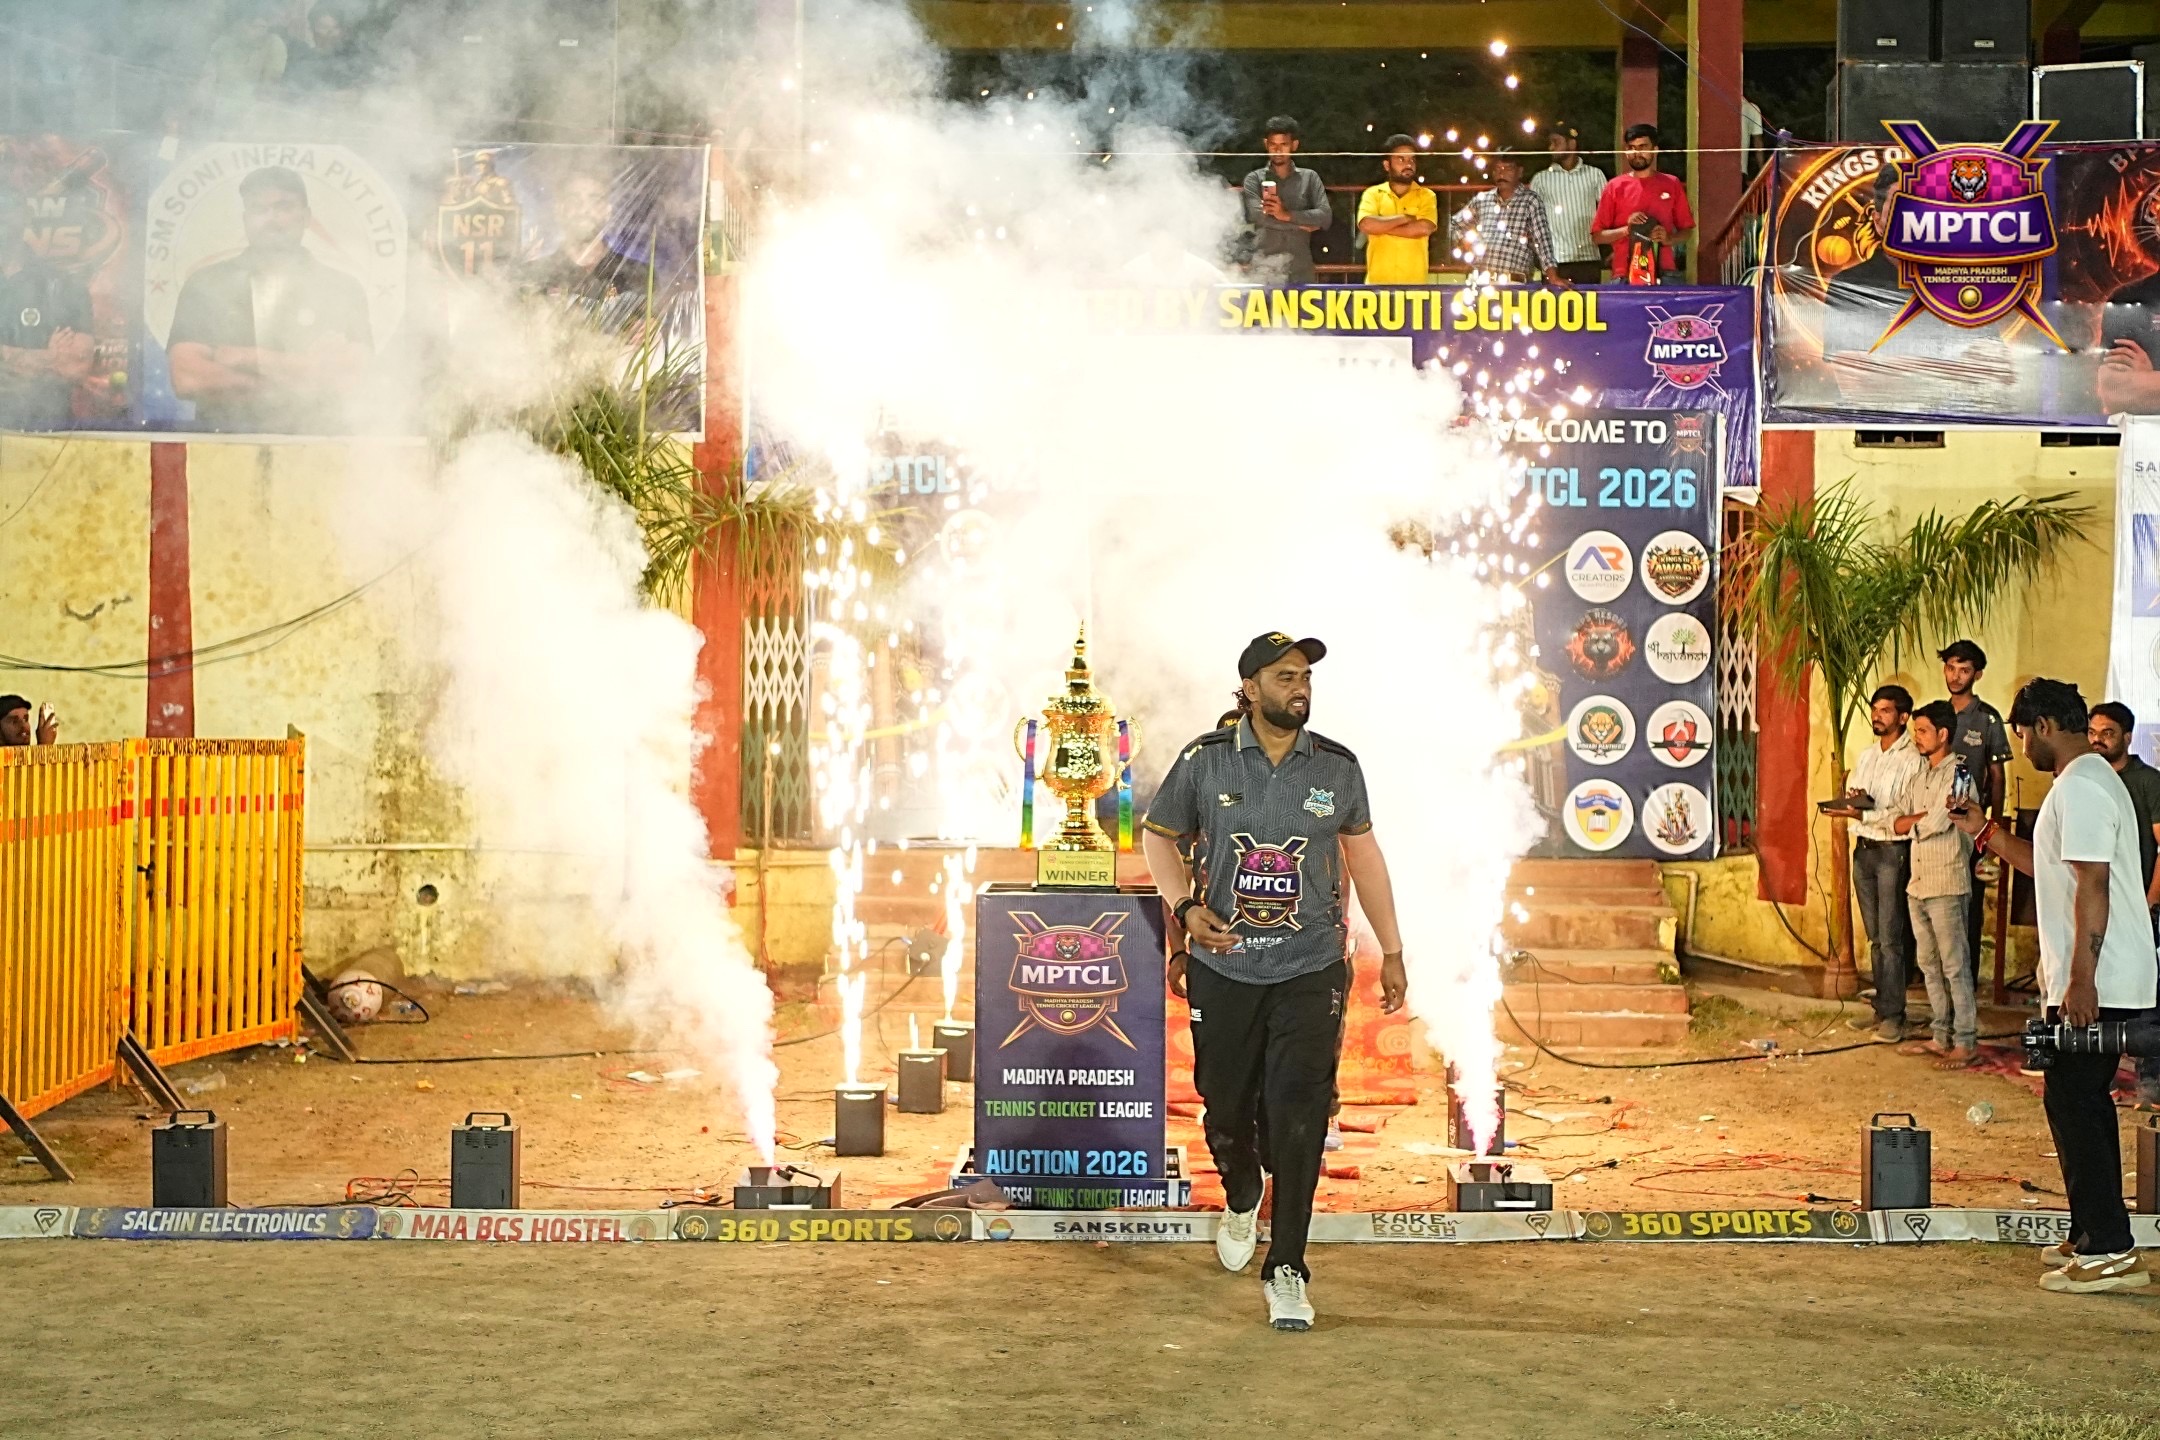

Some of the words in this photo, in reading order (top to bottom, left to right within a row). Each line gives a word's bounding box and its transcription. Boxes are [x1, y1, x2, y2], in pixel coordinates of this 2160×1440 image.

[1800, 149, 1881, 210] KINGS
[148, 216, 177, 262] SM
[163, 157, 224, 216] SONI
[231, 144, 317, 172] INFRA
[323, 158, 377, 203] PVT
[364, 204, 397, 259] LTD
[452, 213, 505, 239] NSR
[460, 240, 495, 275] 11
[1153, 289, 1207, 329] BY
[1218, 288, 1442, 332] SANSKRUTI
[1453, 290, 1608, 332] SCHOOL
[1653, 344, 1722, 359] MPTCL
[1495, 420, 1625, 444] WELCOME
[1634, 420, 1667, 444] TO
[868, 454, 953, 495] PTCL
[2135, 461, 2160, 472] SA
[1600, 467, 1697, 509] 2026
[1571, 573, 1626, 583] CREATORS
[1045, 870, 1109, 882] WINNER
[1238, 874, 1296, 894] MPTCL
[1021, 964, 1117, 985] MPTCL
[1003, 1068, 1065, 1086] MADHYA
[1068, 1069, 1135, 1086] PRADESH
[985, 1100, 1036, 1117] TENNIS
[1039, 1101, 1096, 1118] CRICKET
[1099, 1101, 1153, 1118] LEAGUE
[986, 1149, 1080, 1175] AUCTION
[1086, 1150, 1148, 1176] 2026
[1003, 1186, 1032, 1205] DESH
[1034, 1187, 1074, 1207] TENNIS
[1077, 1188, 1122, 1208] CRICKET
[1124, 1188, 1167, 1207] LEAGUE
[121, 1210, 197, 1231] SACHIN
[199, 1212, 327, 1233] ELECTRONICS
[410, 1214, 467, 1239] MAA
[475, 1216, 525, 1240] BCS
[530, 1217, 627, 1242] HOSTEL
[718, 1219, 780, 1242] 360
[788, 1218, 913, 1242] SPORTS
[1053, 1222, 1192, 1234] SANSKRUTI
[1371, 1213, 1446, 1225] RARE
[1373, 1224, 1457, 1236] ROUGH
[1622, 1212, 1682, 1236] 360
[1690, 1210, 1813, 1236] SPORTS
[1995, 1215, 2071, 1230] RARE
[1998, 1229, 2068, 1240] ROUG
